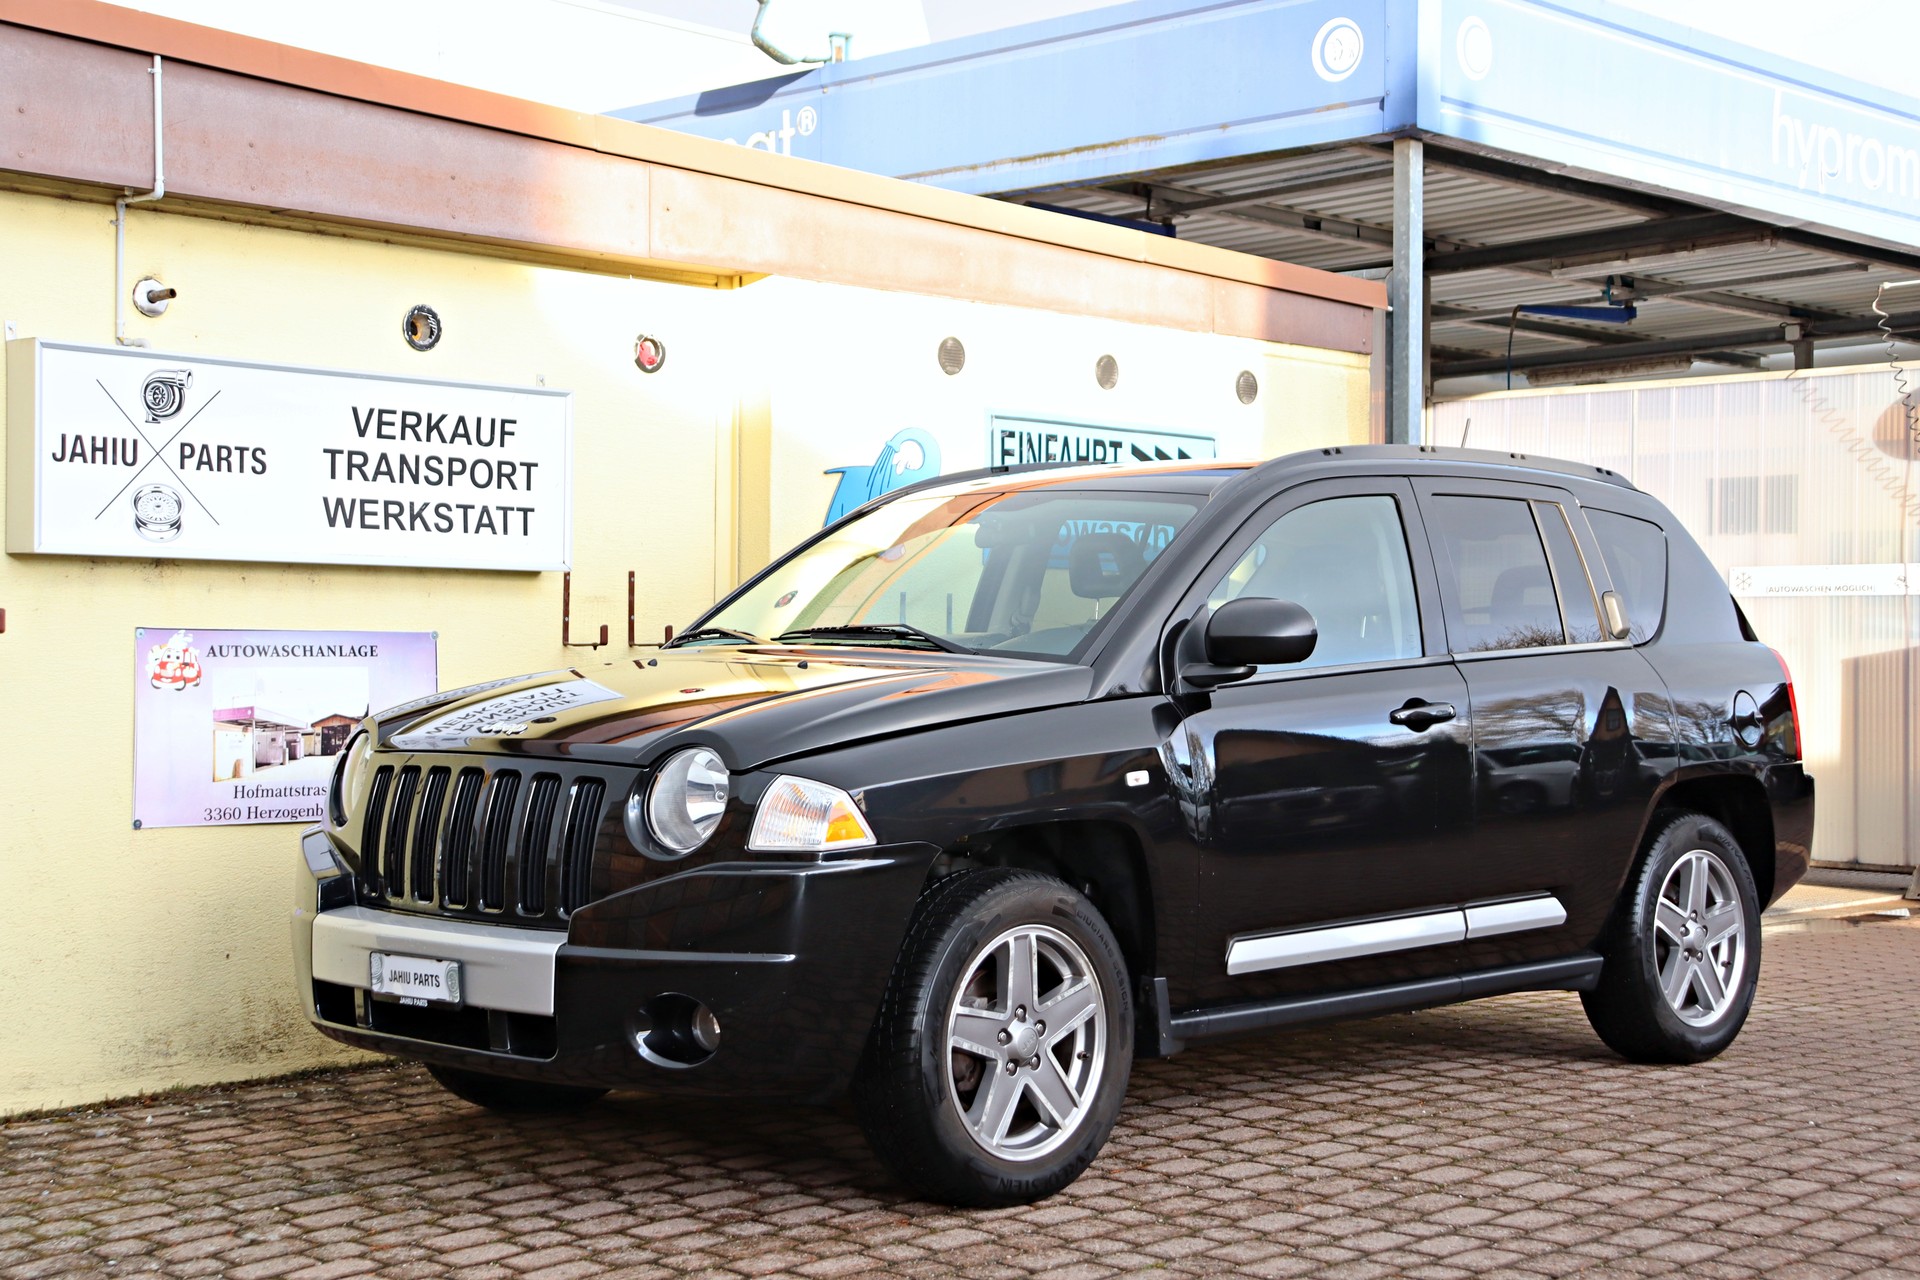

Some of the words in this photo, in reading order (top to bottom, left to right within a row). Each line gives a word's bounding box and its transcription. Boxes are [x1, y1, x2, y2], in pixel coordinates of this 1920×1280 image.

[351, 405, 518, 448] VERKAUF
[51, 433, 139, 467] JAHIU
[179, 442, 268, 475] PARTS
[322, 448, 539, 491] TRANSPORT
[322, 496, 536, 537] WERKSTATT
[206, 644, 379, 658] AUTOWASCHANLAGE
[233, 784, 328, 799] Hofmattstras
[204, 807, 242, 821] 3360
[246, 804, 324, 821] Herzogenb
[388, 969, 411, 985] JAHIU
[413, 972, 441, 988] PARTS
